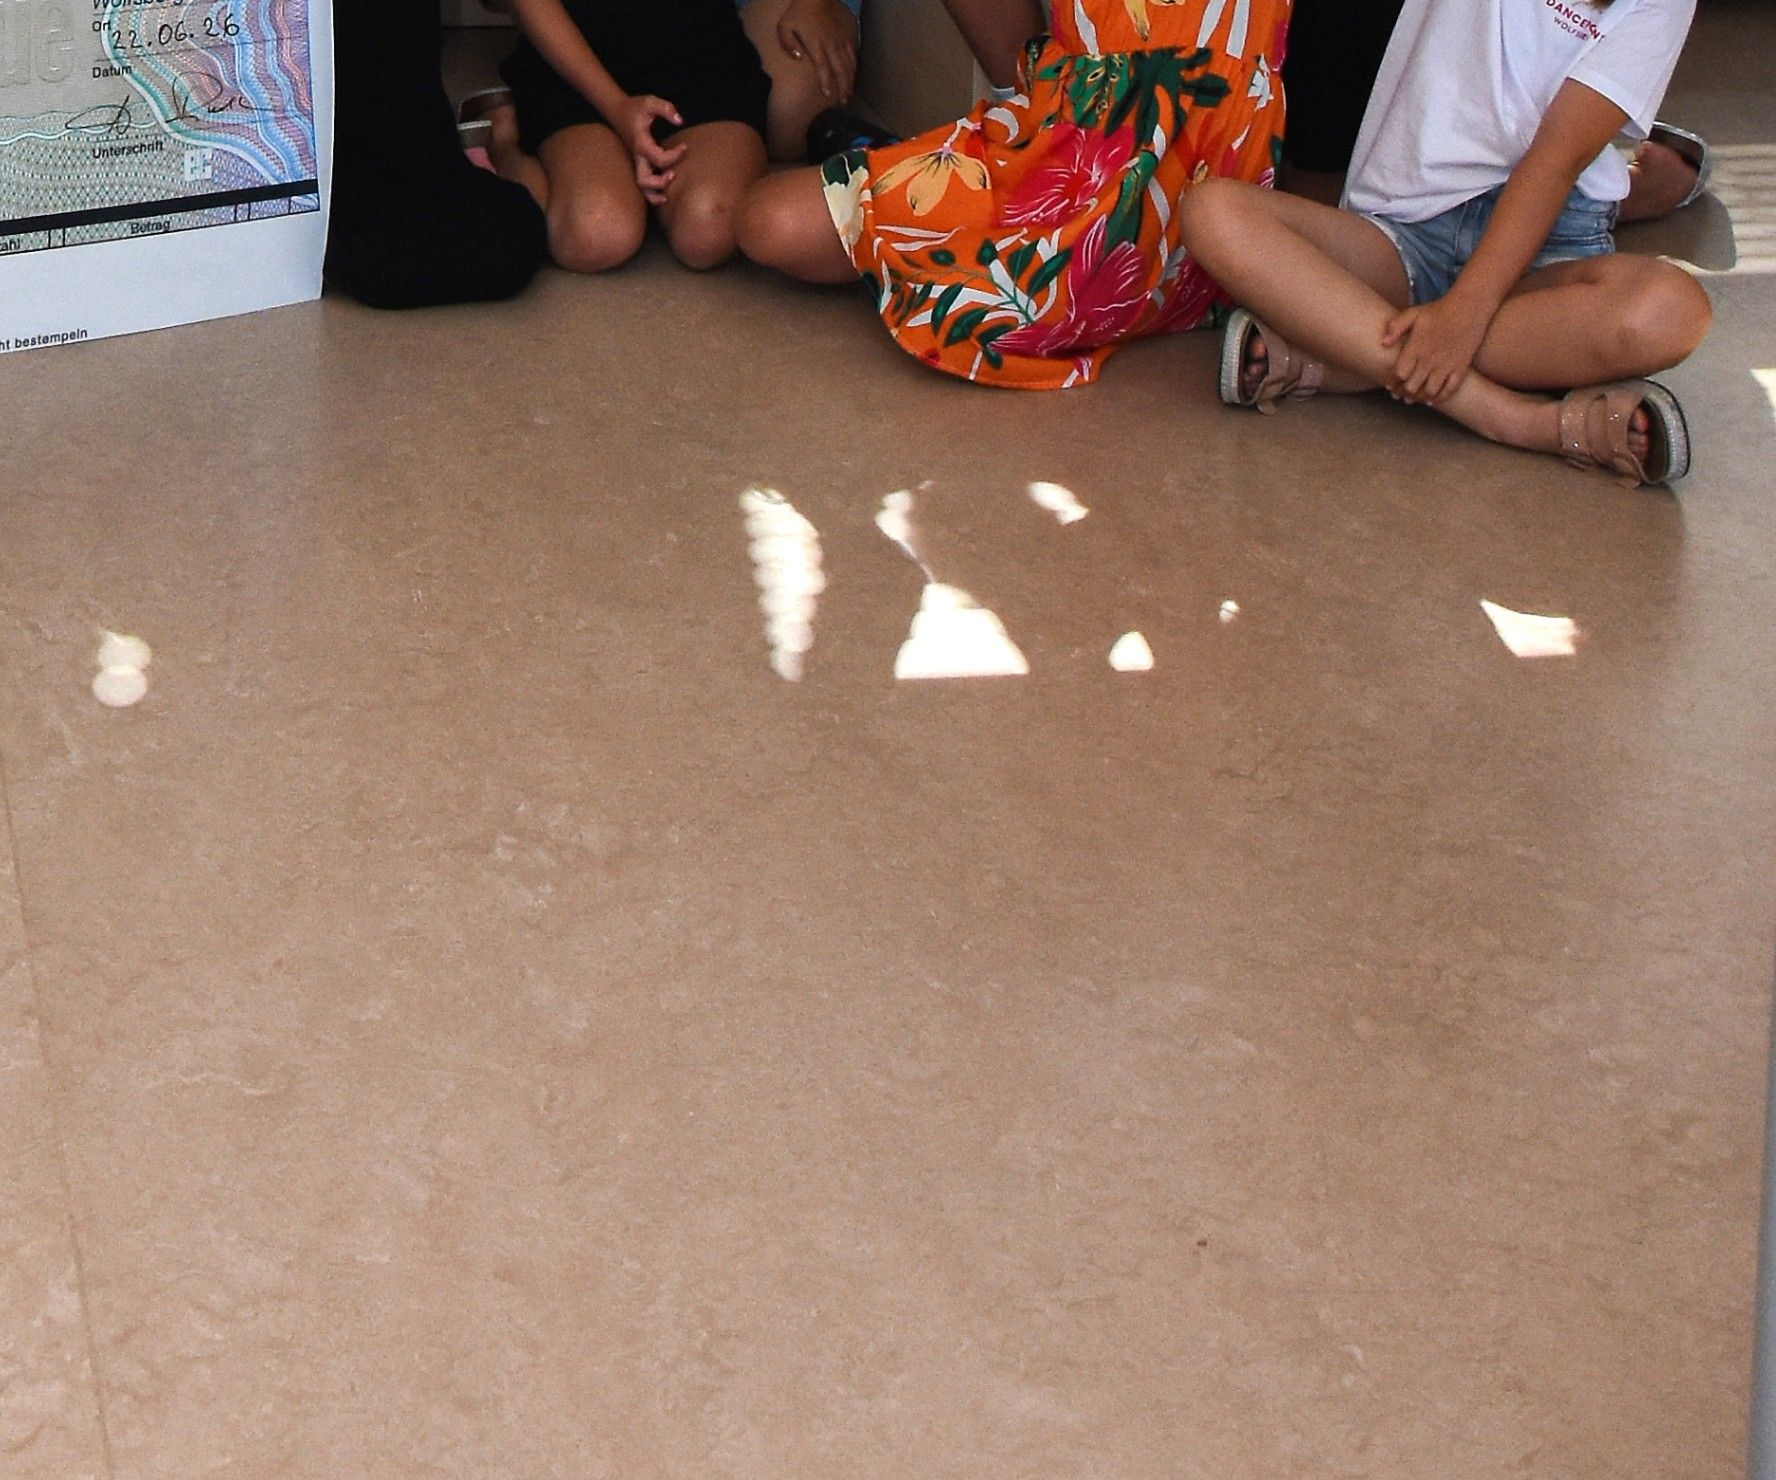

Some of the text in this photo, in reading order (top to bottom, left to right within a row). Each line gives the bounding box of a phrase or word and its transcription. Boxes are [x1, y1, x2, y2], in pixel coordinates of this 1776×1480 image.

[91, 19, 112, 33] Ort
[91, 65, 133, 79] Datum
[91, 141, 164, 159] Unterschrift
[130, 218, 172, 235] Betrag
[14, 328, 88, 349] bestempeln
